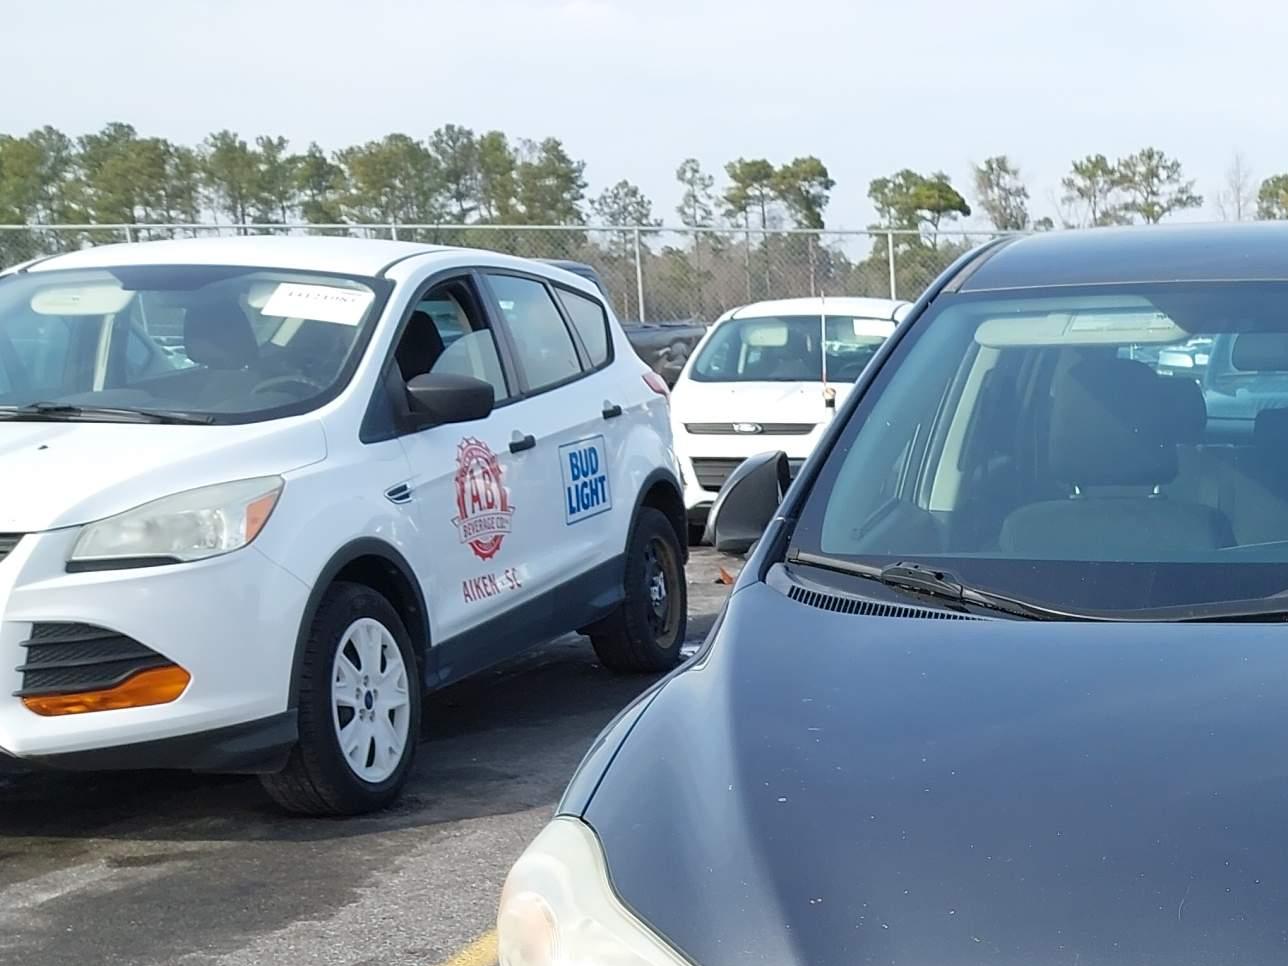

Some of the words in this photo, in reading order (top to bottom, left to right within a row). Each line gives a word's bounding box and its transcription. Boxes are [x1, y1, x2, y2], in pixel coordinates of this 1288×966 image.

[569, 446, 600, 482] BUD
[567, 475, 607, 516] LIGHT
[463, 573, 502, 603] AIKEN
[504, 567, 522, 590] SC
